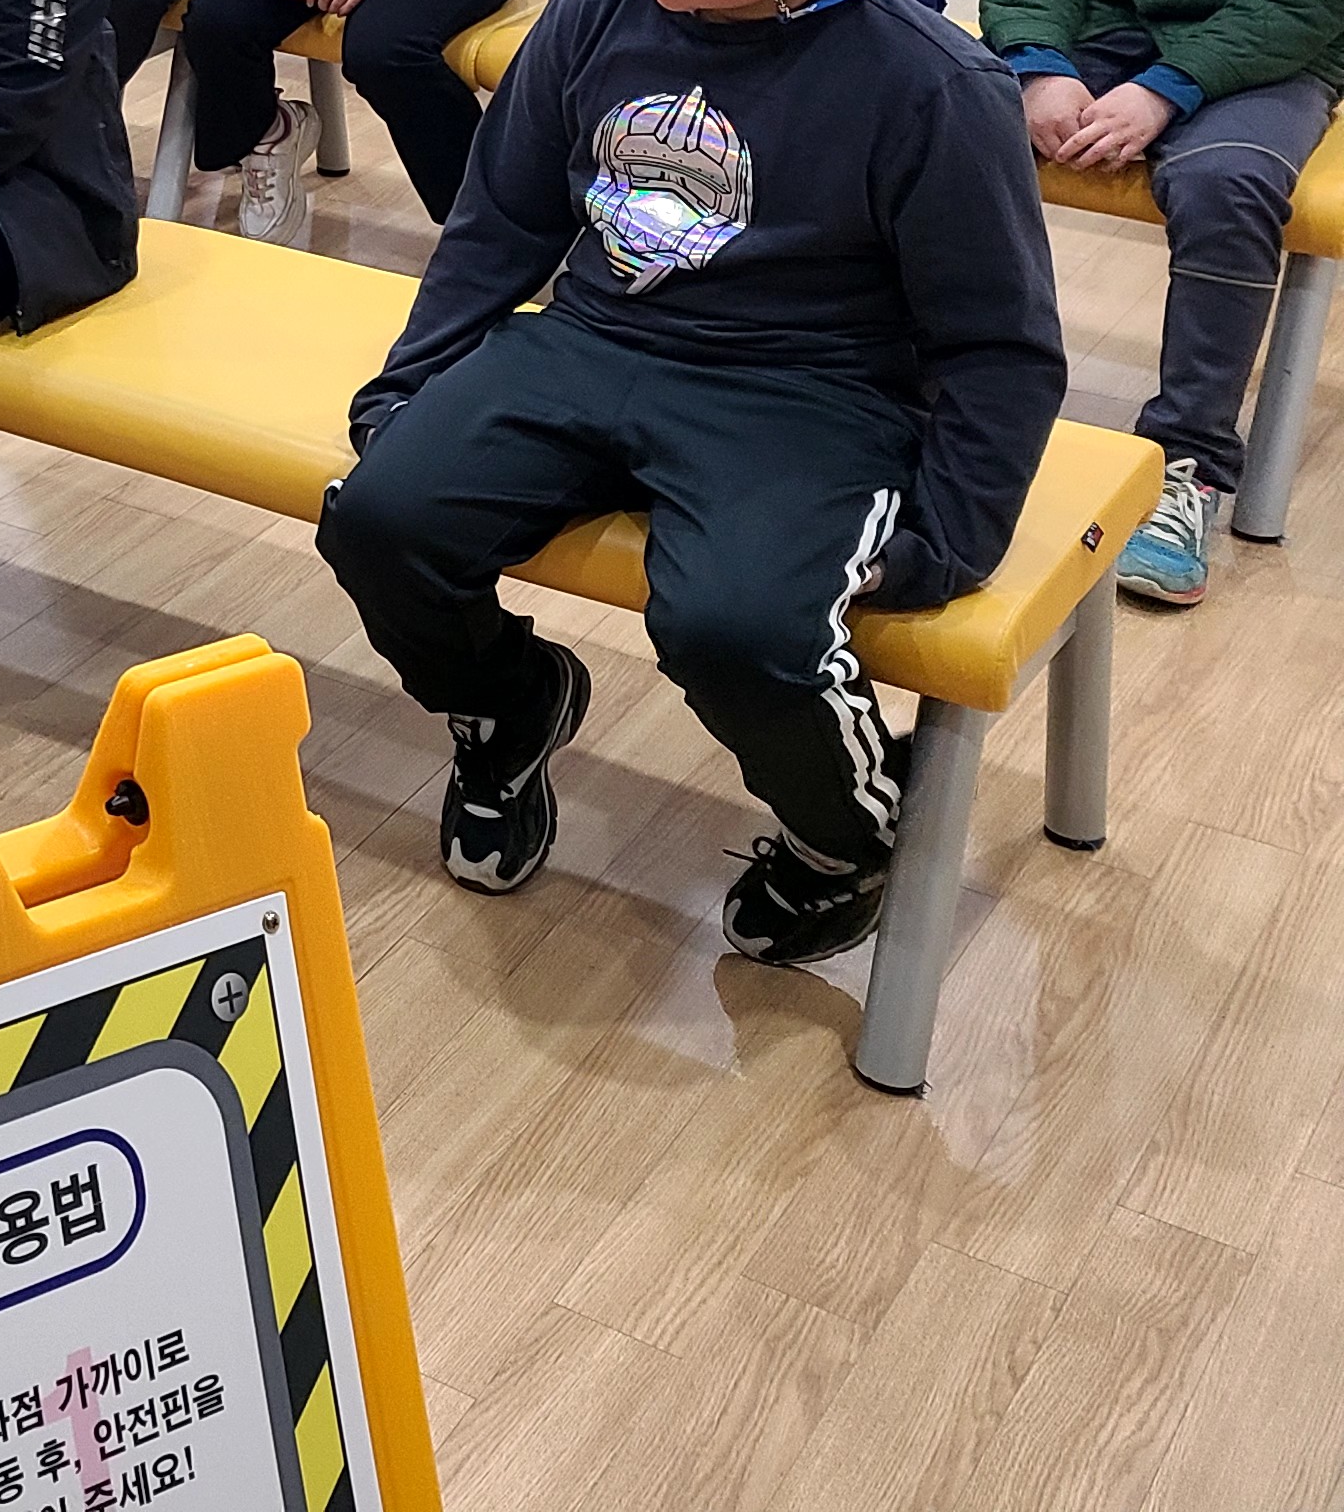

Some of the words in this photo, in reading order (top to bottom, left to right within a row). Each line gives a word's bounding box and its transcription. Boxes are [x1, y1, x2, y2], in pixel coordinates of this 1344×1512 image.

[56, 1329, 190, 1412] 가까이로
[36, 1438, 81, 1484] 후,
[93, 1374, 224, 1462] 안전핀을
[83, 1445, 196, 1512] 주세요!
